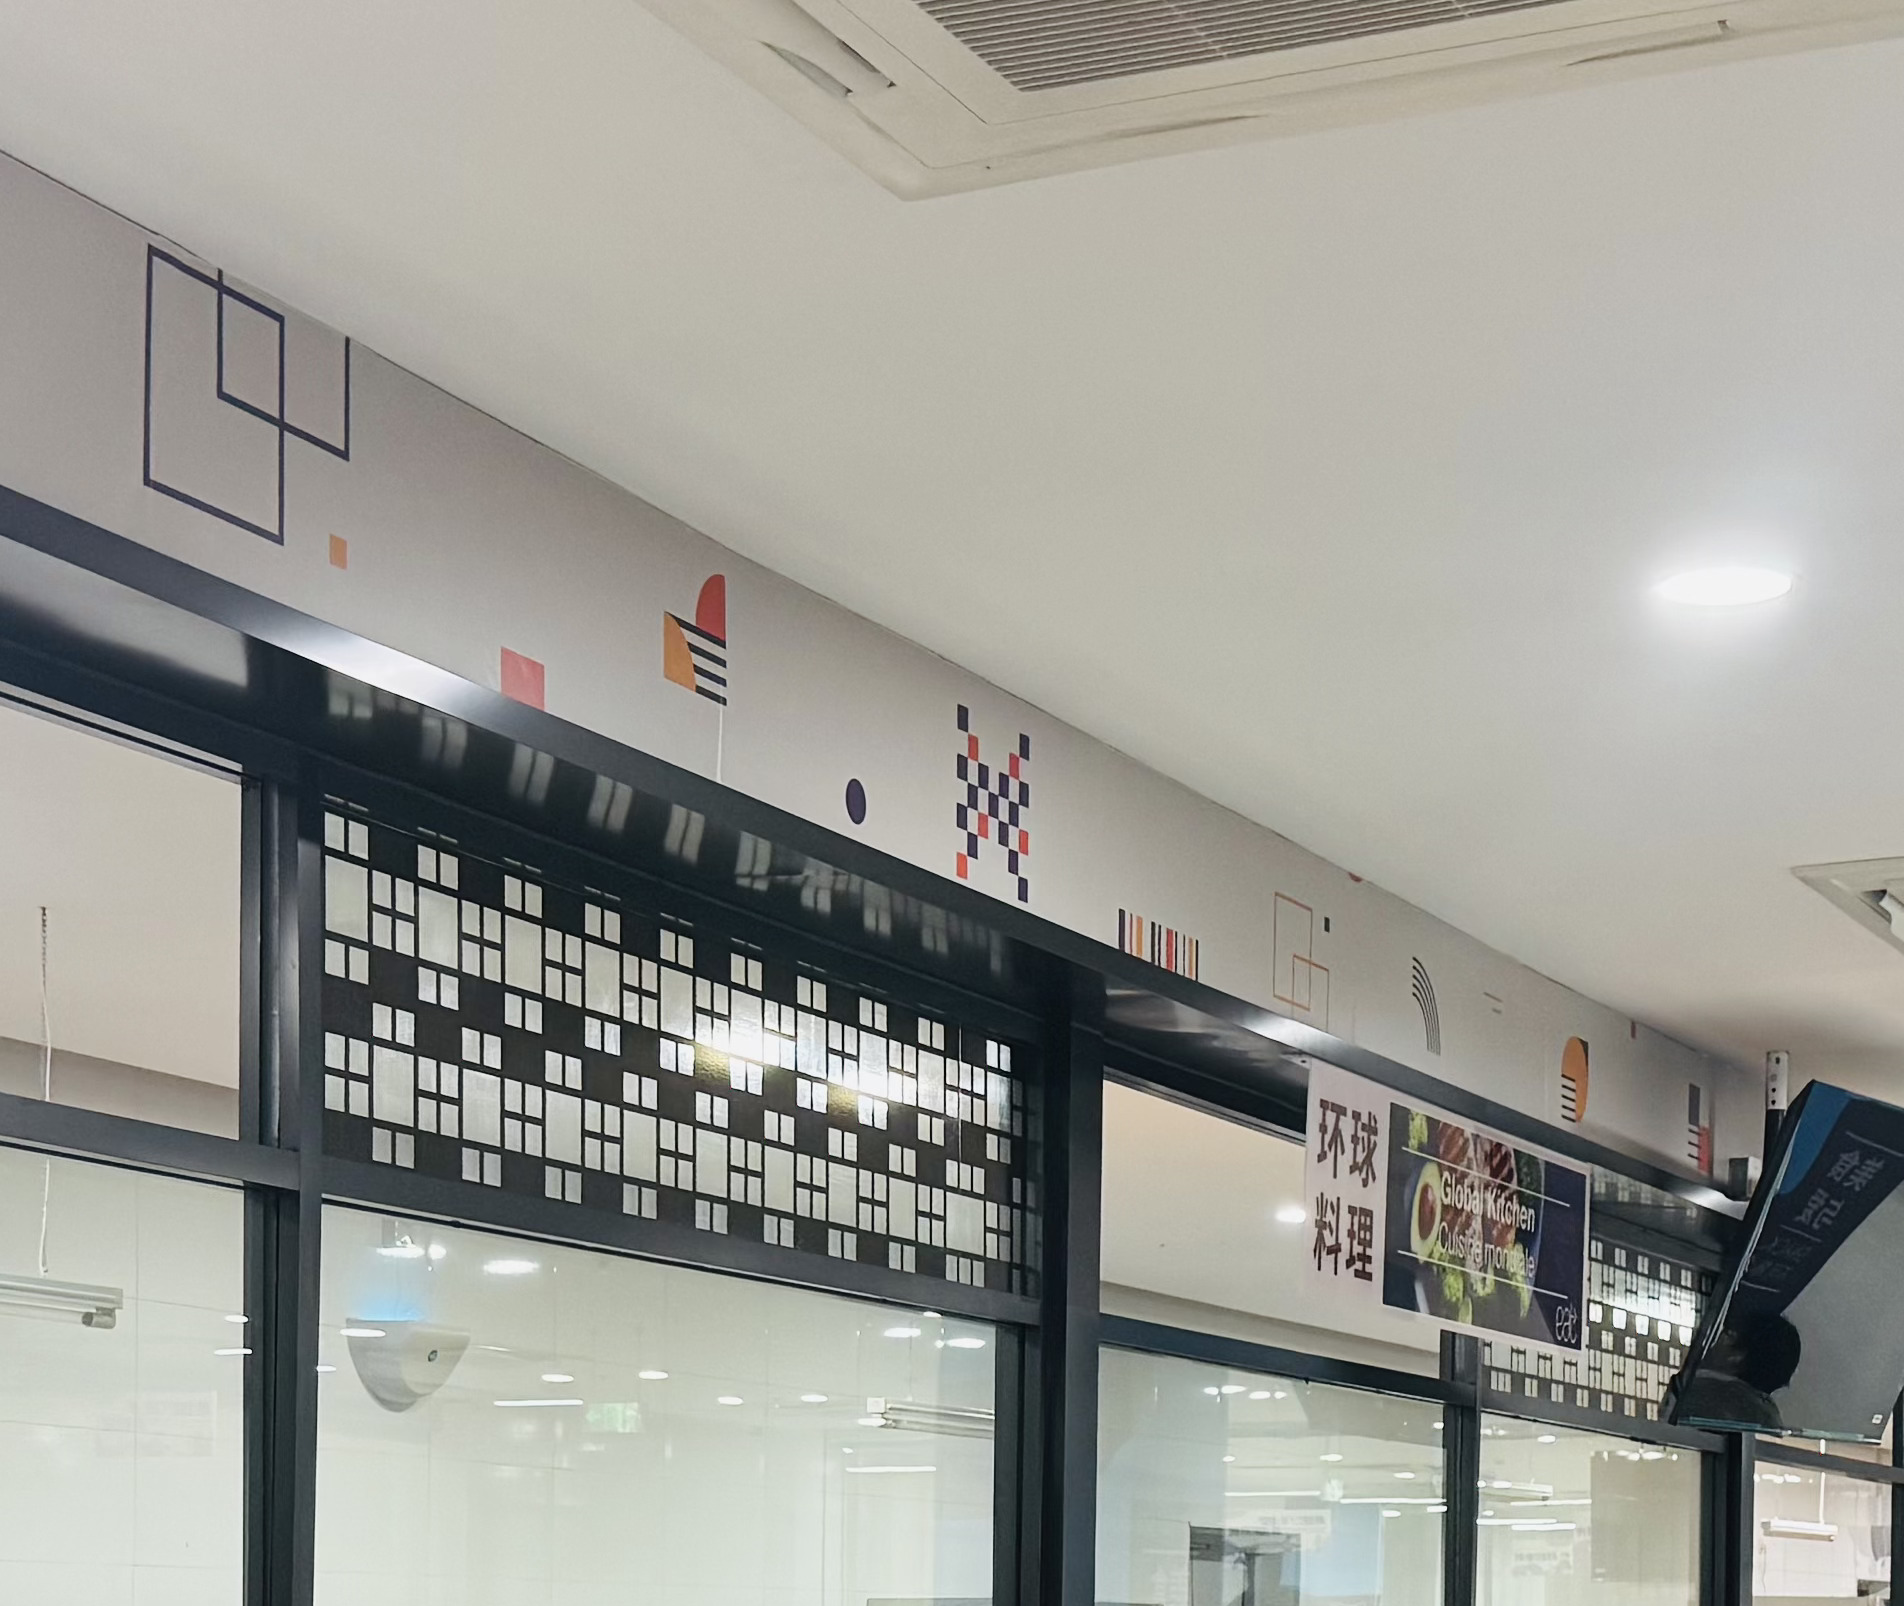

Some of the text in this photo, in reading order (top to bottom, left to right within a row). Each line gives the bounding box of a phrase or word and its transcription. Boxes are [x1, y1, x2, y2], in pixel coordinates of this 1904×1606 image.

[1317, 1098, 1379, 1188] 环球
[1440, 1170, 1536, 1233] Global Kitchen
[1312, 1191, 1375, 1283] 料理
[1439, 1221, 1483, 1264] Cuisine
[1555, 1301, 1579, 1345] eat
